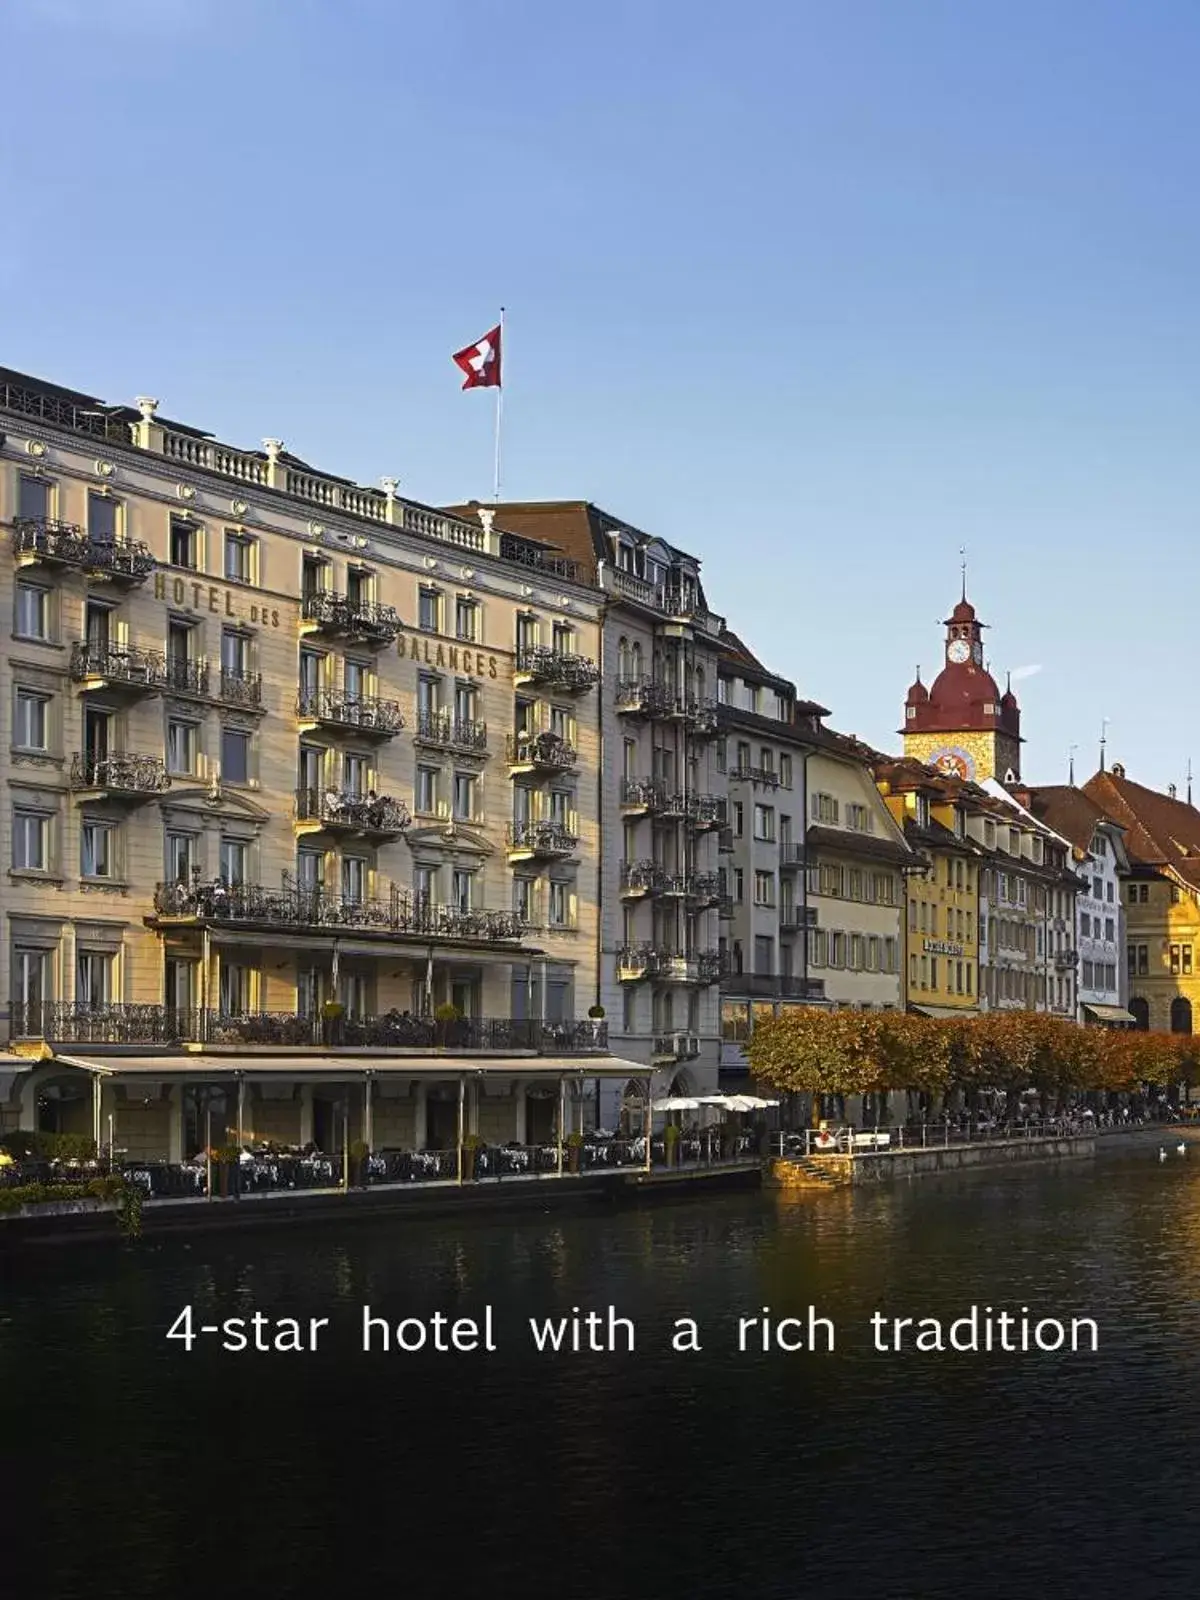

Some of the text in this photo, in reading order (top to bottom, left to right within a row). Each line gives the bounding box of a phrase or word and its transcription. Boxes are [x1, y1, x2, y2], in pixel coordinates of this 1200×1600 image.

[154, 572, 497, 679] HOTEL DES BALANCES
